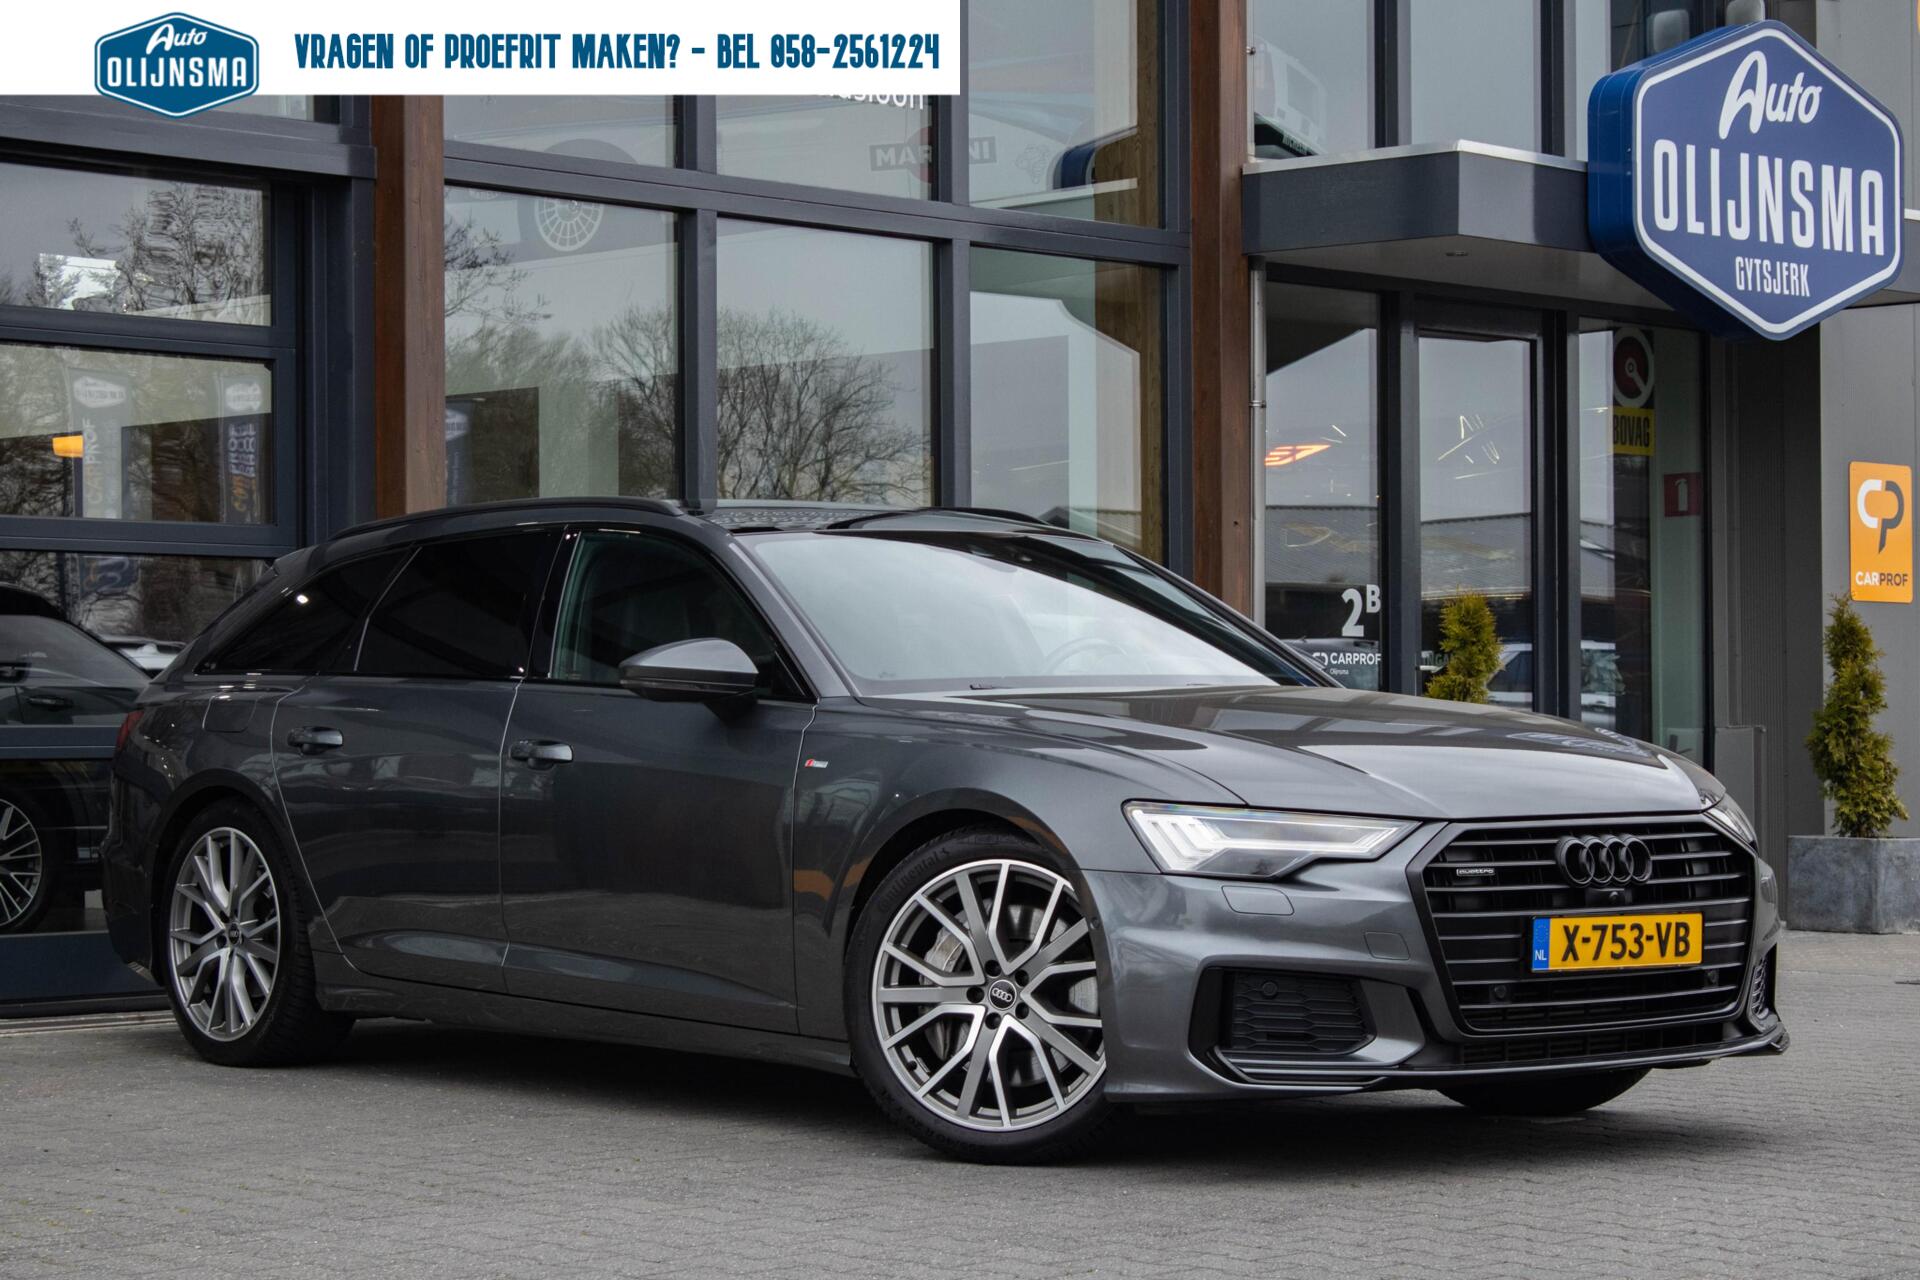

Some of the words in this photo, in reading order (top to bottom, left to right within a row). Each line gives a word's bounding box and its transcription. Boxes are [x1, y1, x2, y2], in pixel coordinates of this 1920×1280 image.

[1719, 50, 1822, 140] Auto
[1653, 139, 1885, 256] OLIJNSMA
[1735, 256, 1810, 297] GYTSJERK
[1612, 414, 1650, 448] BOVAG
[1855, 571, 1908, 586] CARPROF
[1330, 652, 1382, 665] CARPROF
[1534, 950, 1547, 961] NL
[1561, 922, 1690, 962] X-753-VB
